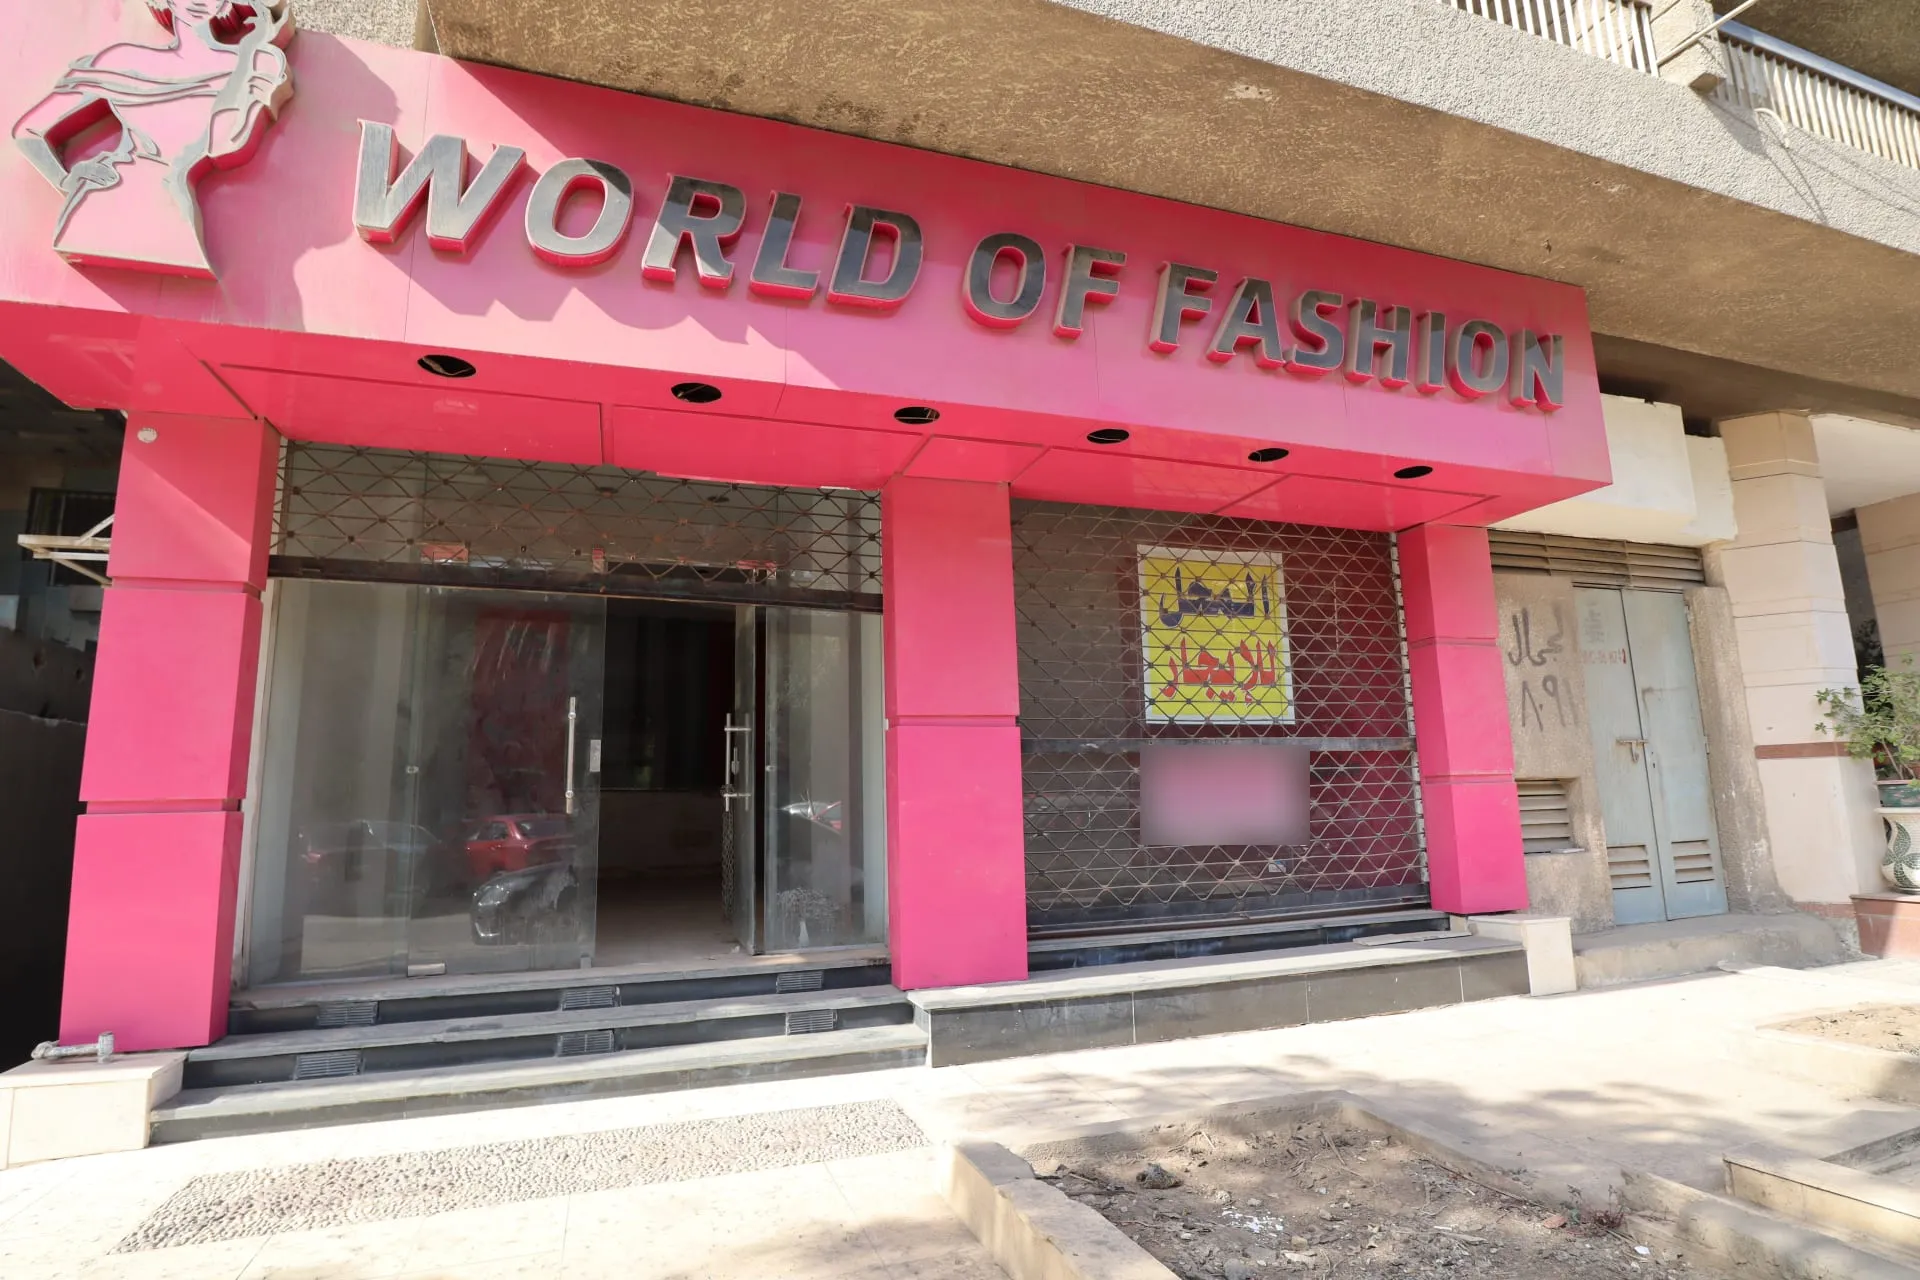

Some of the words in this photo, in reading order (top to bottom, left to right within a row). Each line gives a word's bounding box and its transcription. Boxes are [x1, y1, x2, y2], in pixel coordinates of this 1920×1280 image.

[353, 119, 924, 310] WORLD
[962, 232, 1128, 340] OF
[1148, 261, 1565, 413] FASHION
[1158, 566, 1270, 628] المحل
